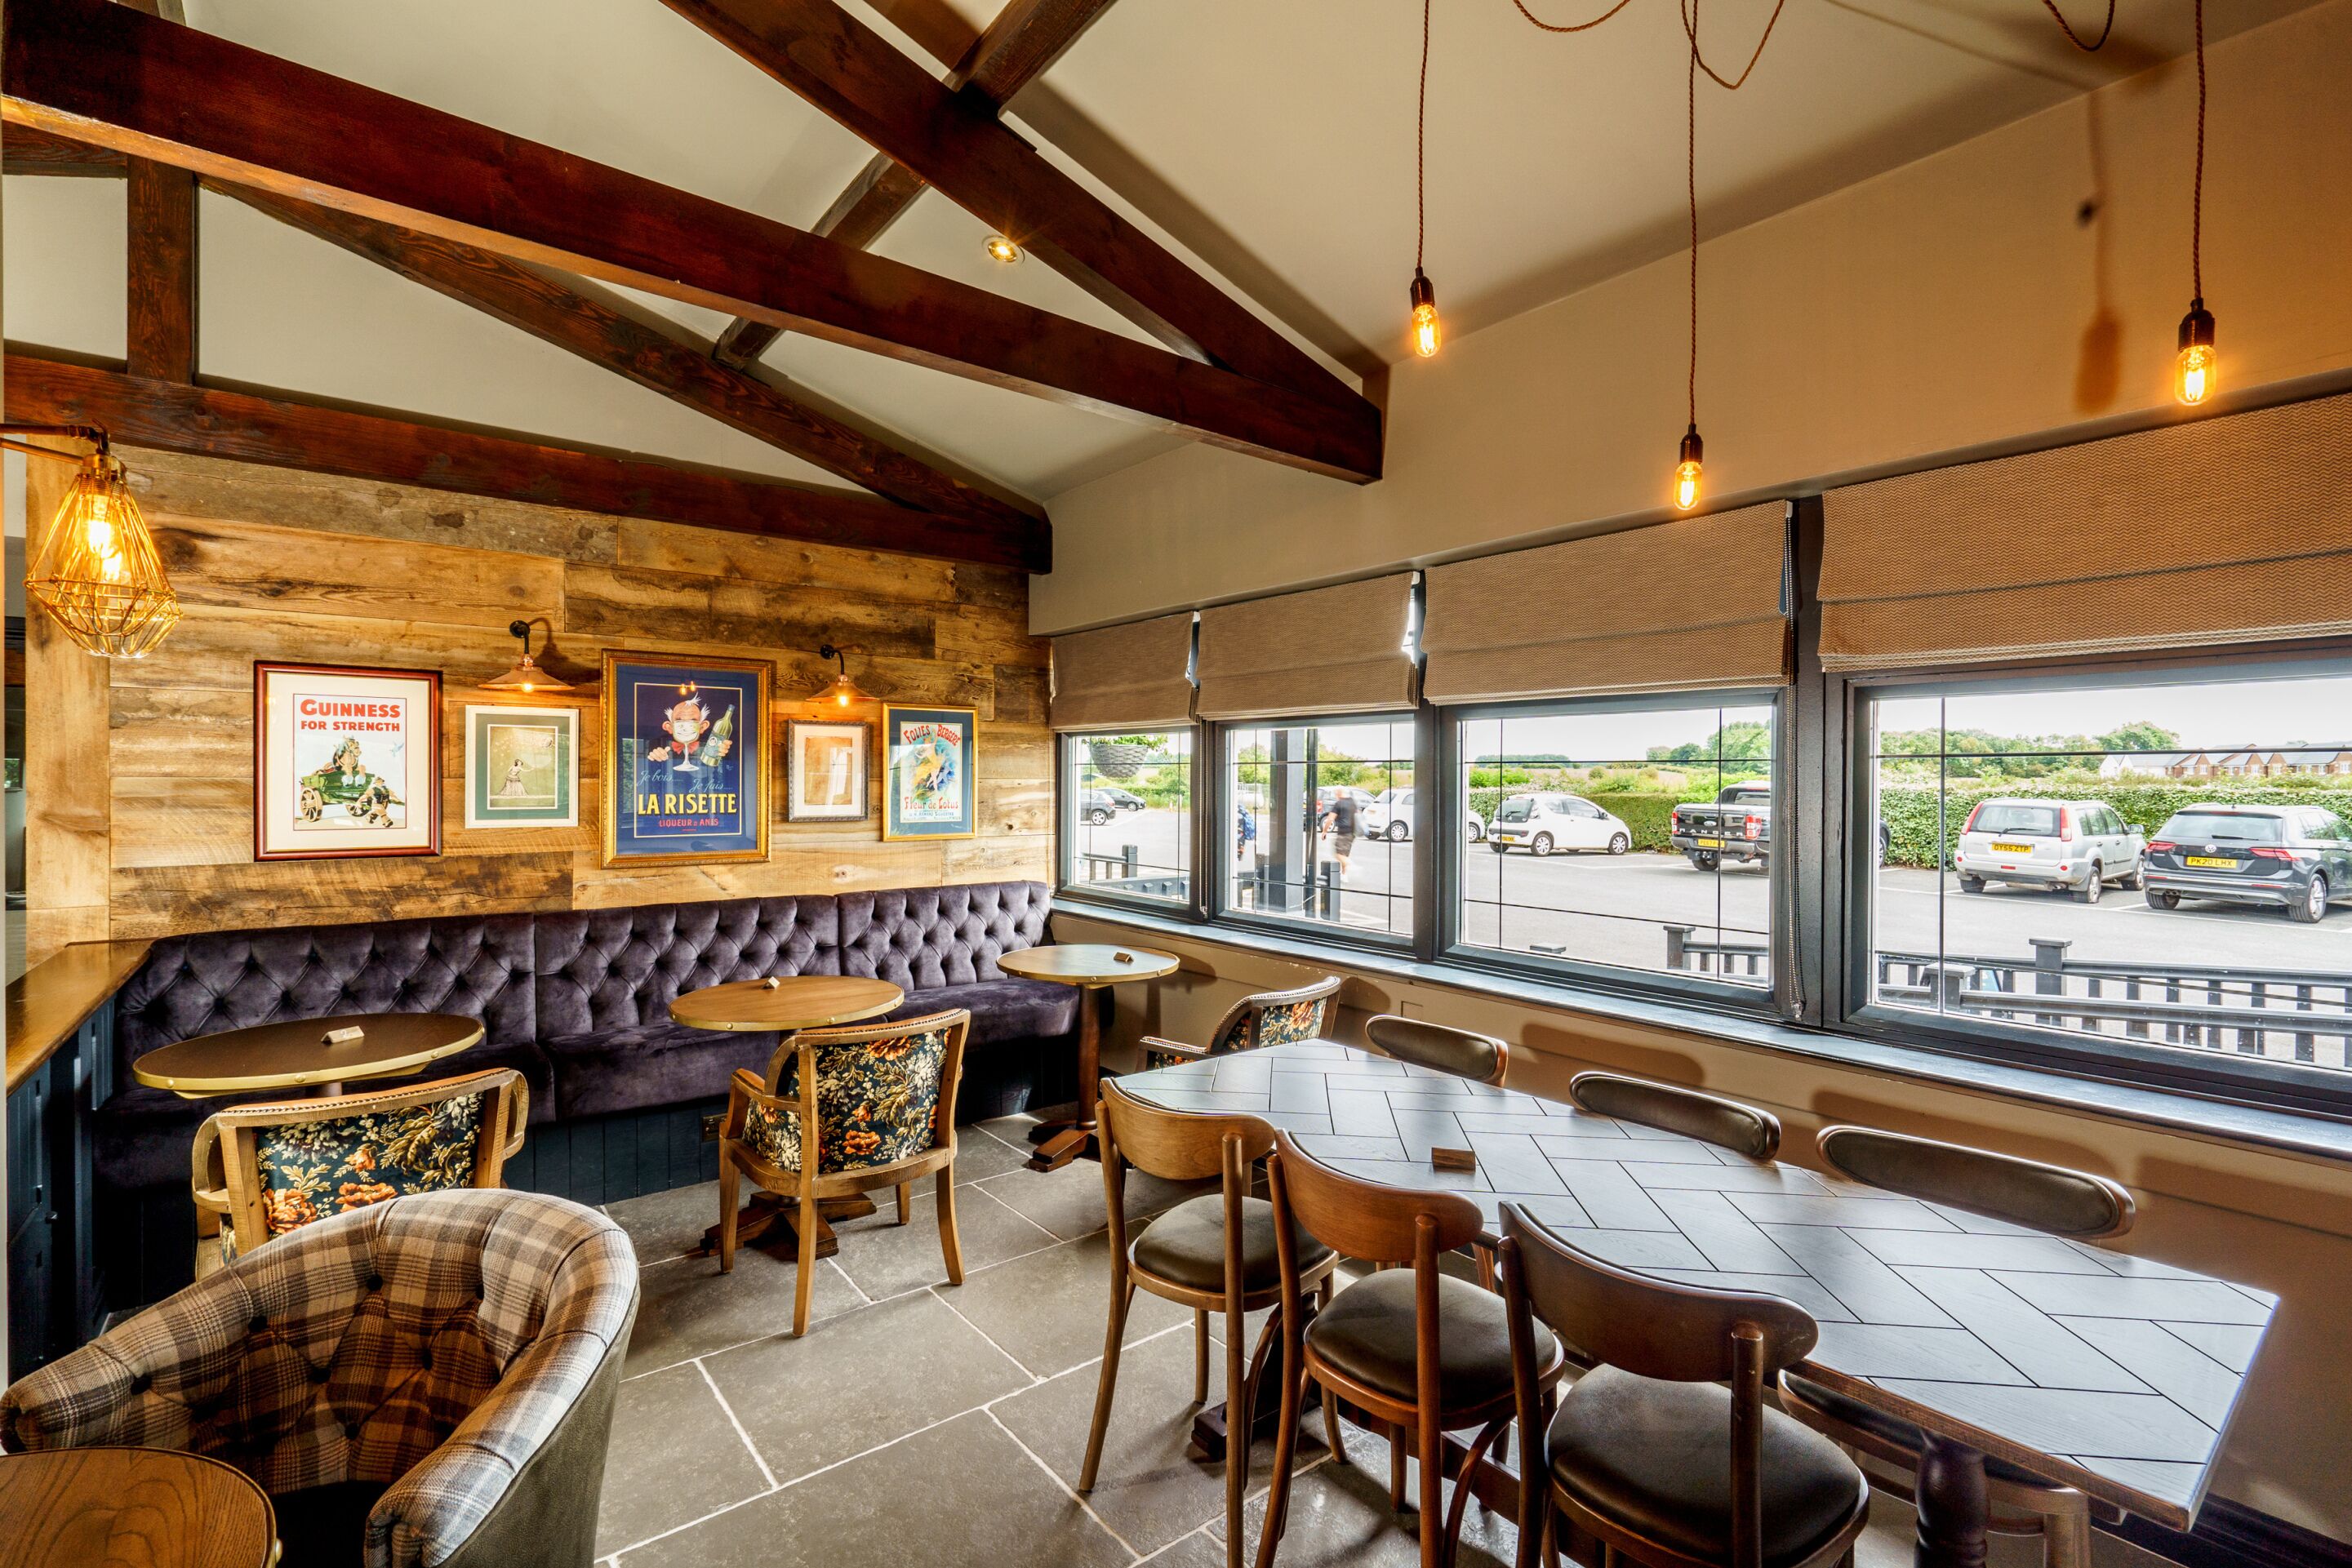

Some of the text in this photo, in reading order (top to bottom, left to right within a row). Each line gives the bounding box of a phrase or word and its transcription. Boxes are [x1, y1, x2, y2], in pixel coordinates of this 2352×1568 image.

[300, 699, 401, 718] GUINNESS
[300, 720, 400, 732] FOR STRENGTH
[903, 724, 931, 744] FOLIES
[637, 770, 651, 786] Je
[689, 778, 703, 793] Je
[638, 793, 737, 815] LA RISETTE
[904, 796, 927, 810] Fleur
[938, 796, 958, 810] Lotus
[659, 819, 692, 827] LIQUEUR
[699, 818, 719, 826] ANIS
[1678, 828, 1743, 837] RANGER
